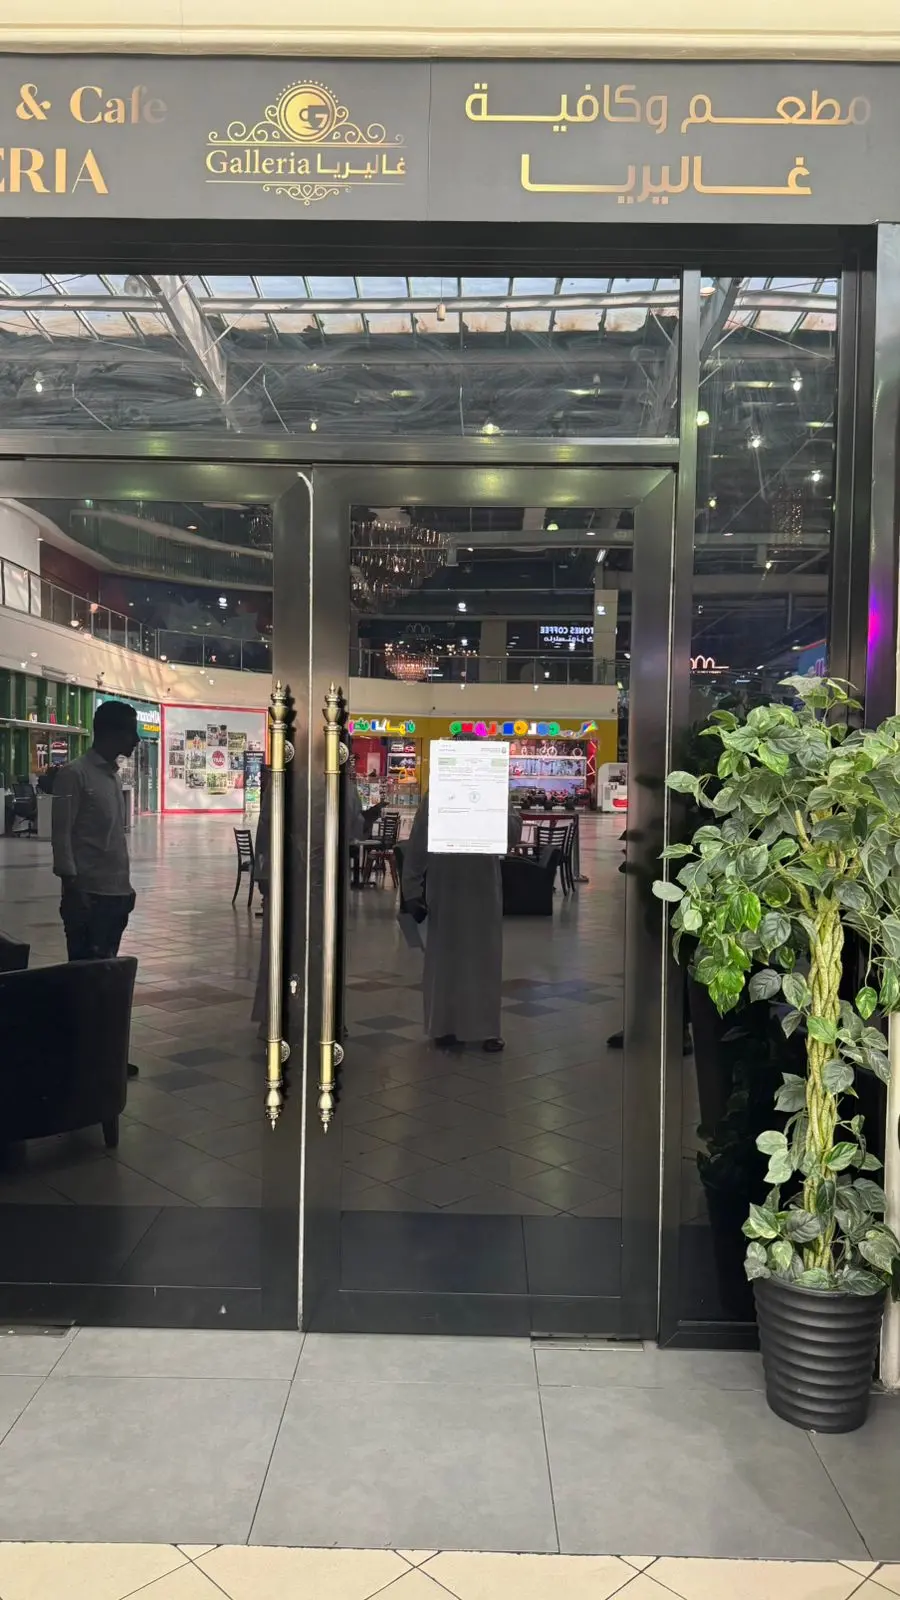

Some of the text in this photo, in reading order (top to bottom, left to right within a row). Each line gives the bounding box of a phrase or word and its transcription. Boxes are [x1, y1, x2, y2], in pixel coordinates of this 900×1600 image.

[15, 83, 168, 125] & Cafe
[465, 82, 872, 134] مطعم وكافية
[0, 147, 109, 194] RIA
[205, 149, 310, 175] Galleria
[316, 152, 406, 179] غاليريا
[520, 153, 812, 205] غاليريا
